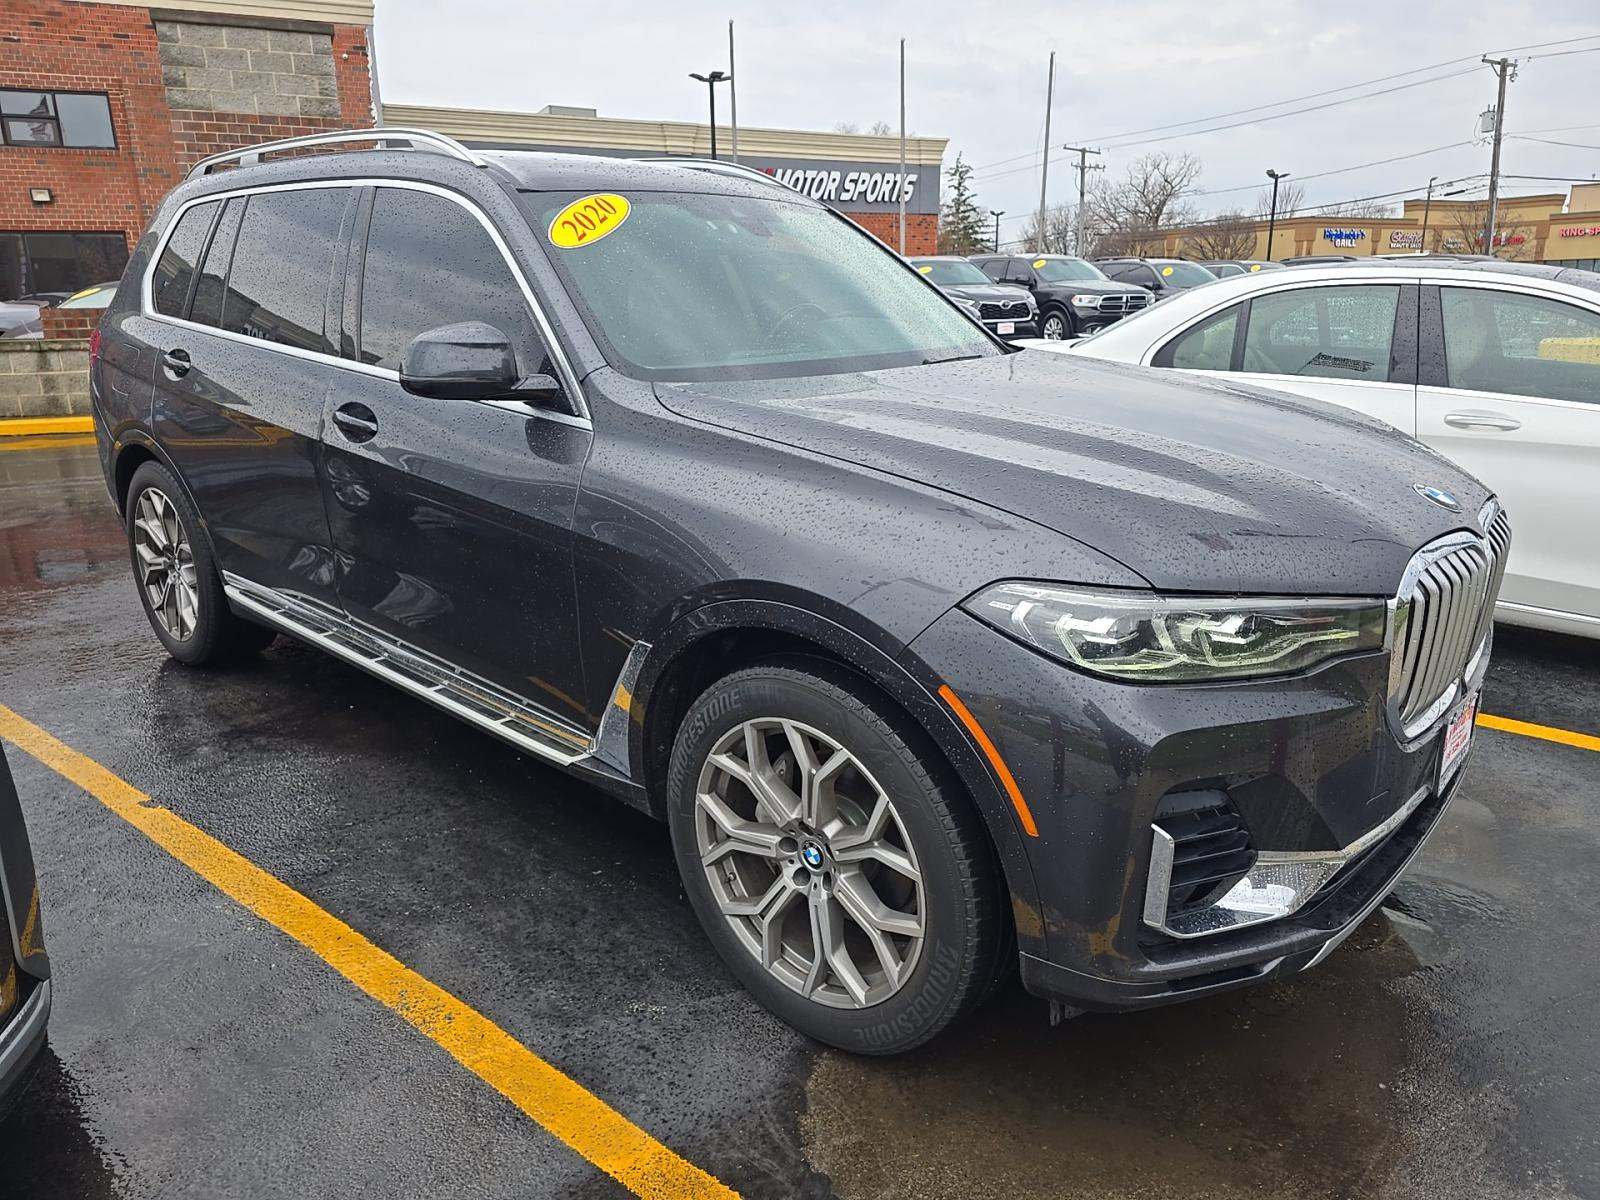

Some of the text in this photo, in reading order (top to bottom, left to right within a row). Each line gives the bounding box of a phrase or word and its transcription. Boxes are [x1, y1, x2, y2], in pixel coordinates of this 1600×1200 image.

[775, 168, 918, 204] MOTOR SPORTS
[562, 197, 617, 241] 2020
[1333, 238, 1357, 248] GRILL
[1560, 227, 1585, 237] KING
